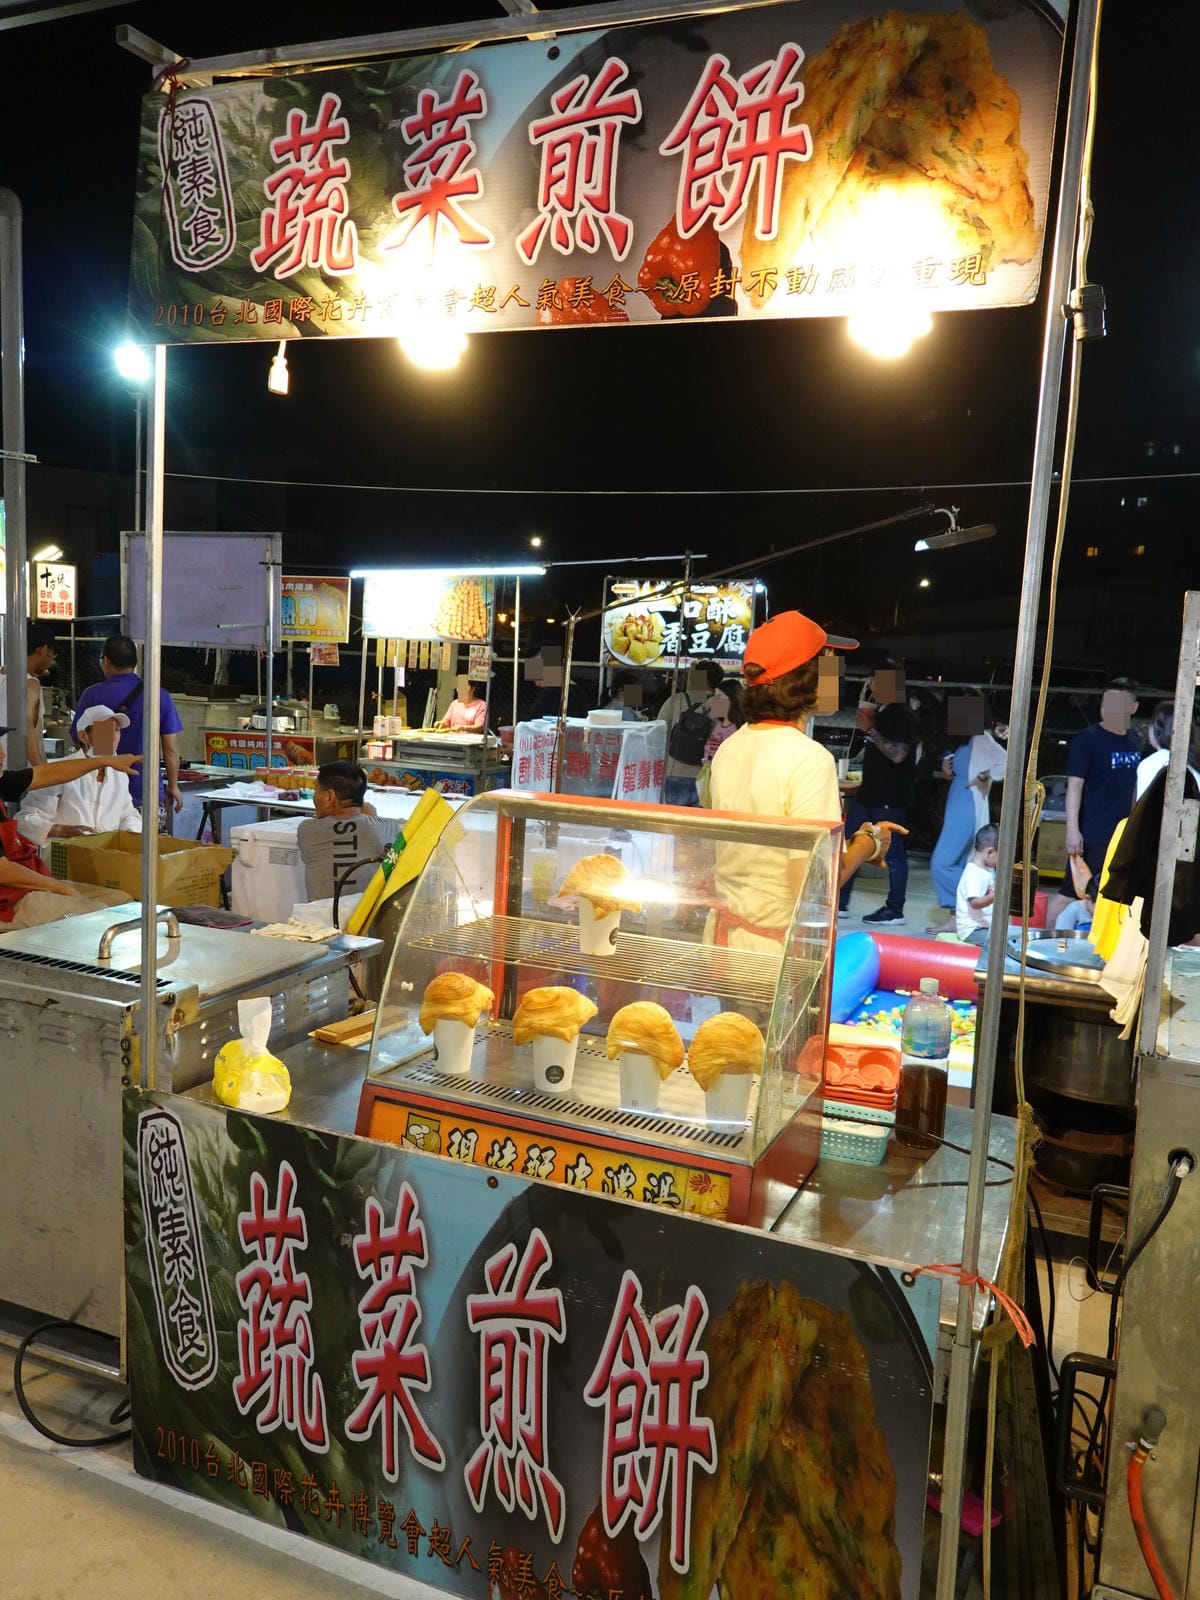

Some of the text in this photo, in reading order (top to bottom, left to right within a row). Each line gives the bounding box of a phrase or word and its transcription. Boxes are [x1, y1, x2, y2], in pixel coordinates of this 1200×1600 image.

[171, 109, 224, 257] 純素食
[251, 42, 813, 279] 蔬菜煎餅
[659, 622, 746, 655] 香豆腐
[147, 1127, 207, 1364] 純素食
[233, 1160, 718, 1574] 蔬菜煎餅
